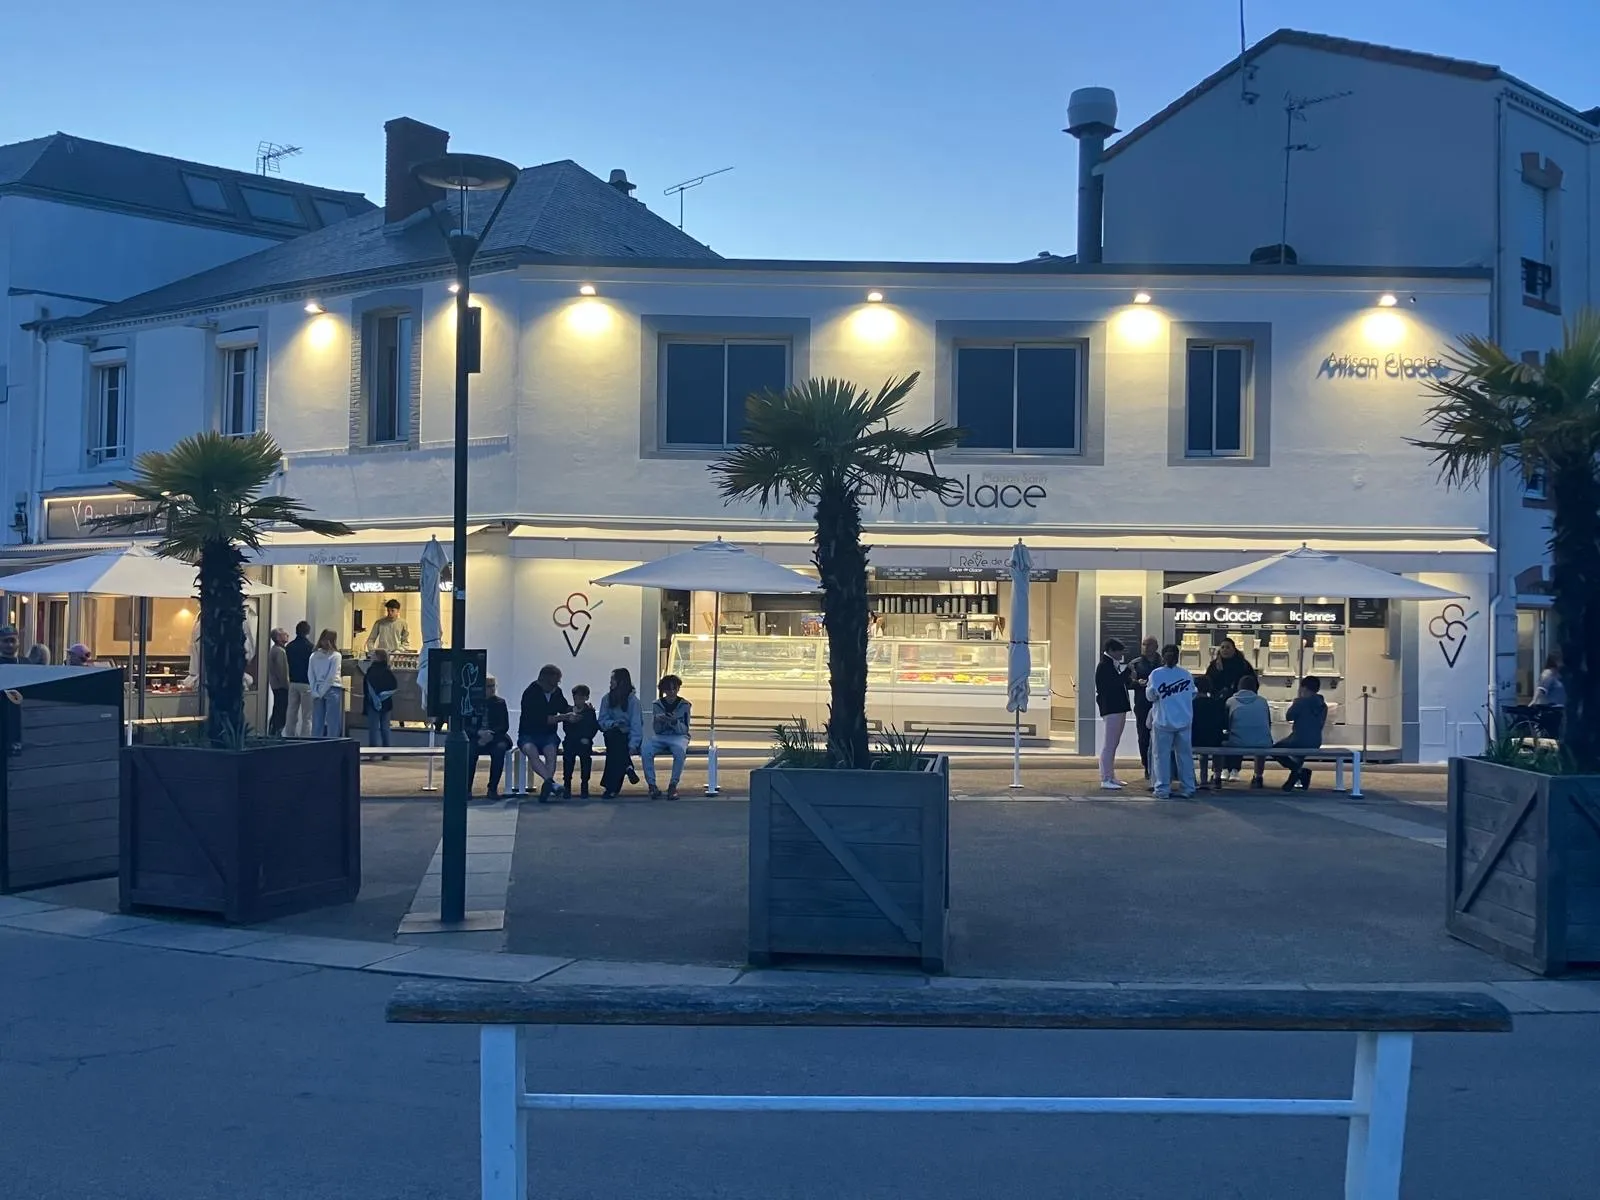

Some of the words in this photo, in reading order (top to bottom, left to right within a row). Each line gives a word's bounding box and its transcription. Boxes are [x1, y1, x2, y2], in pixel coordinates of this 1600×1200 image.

[938, 474, 1047, 509] Glace
[1174, 608, 1211, 622] rtisan
[1213, 606, 1263, 622] Glacier
